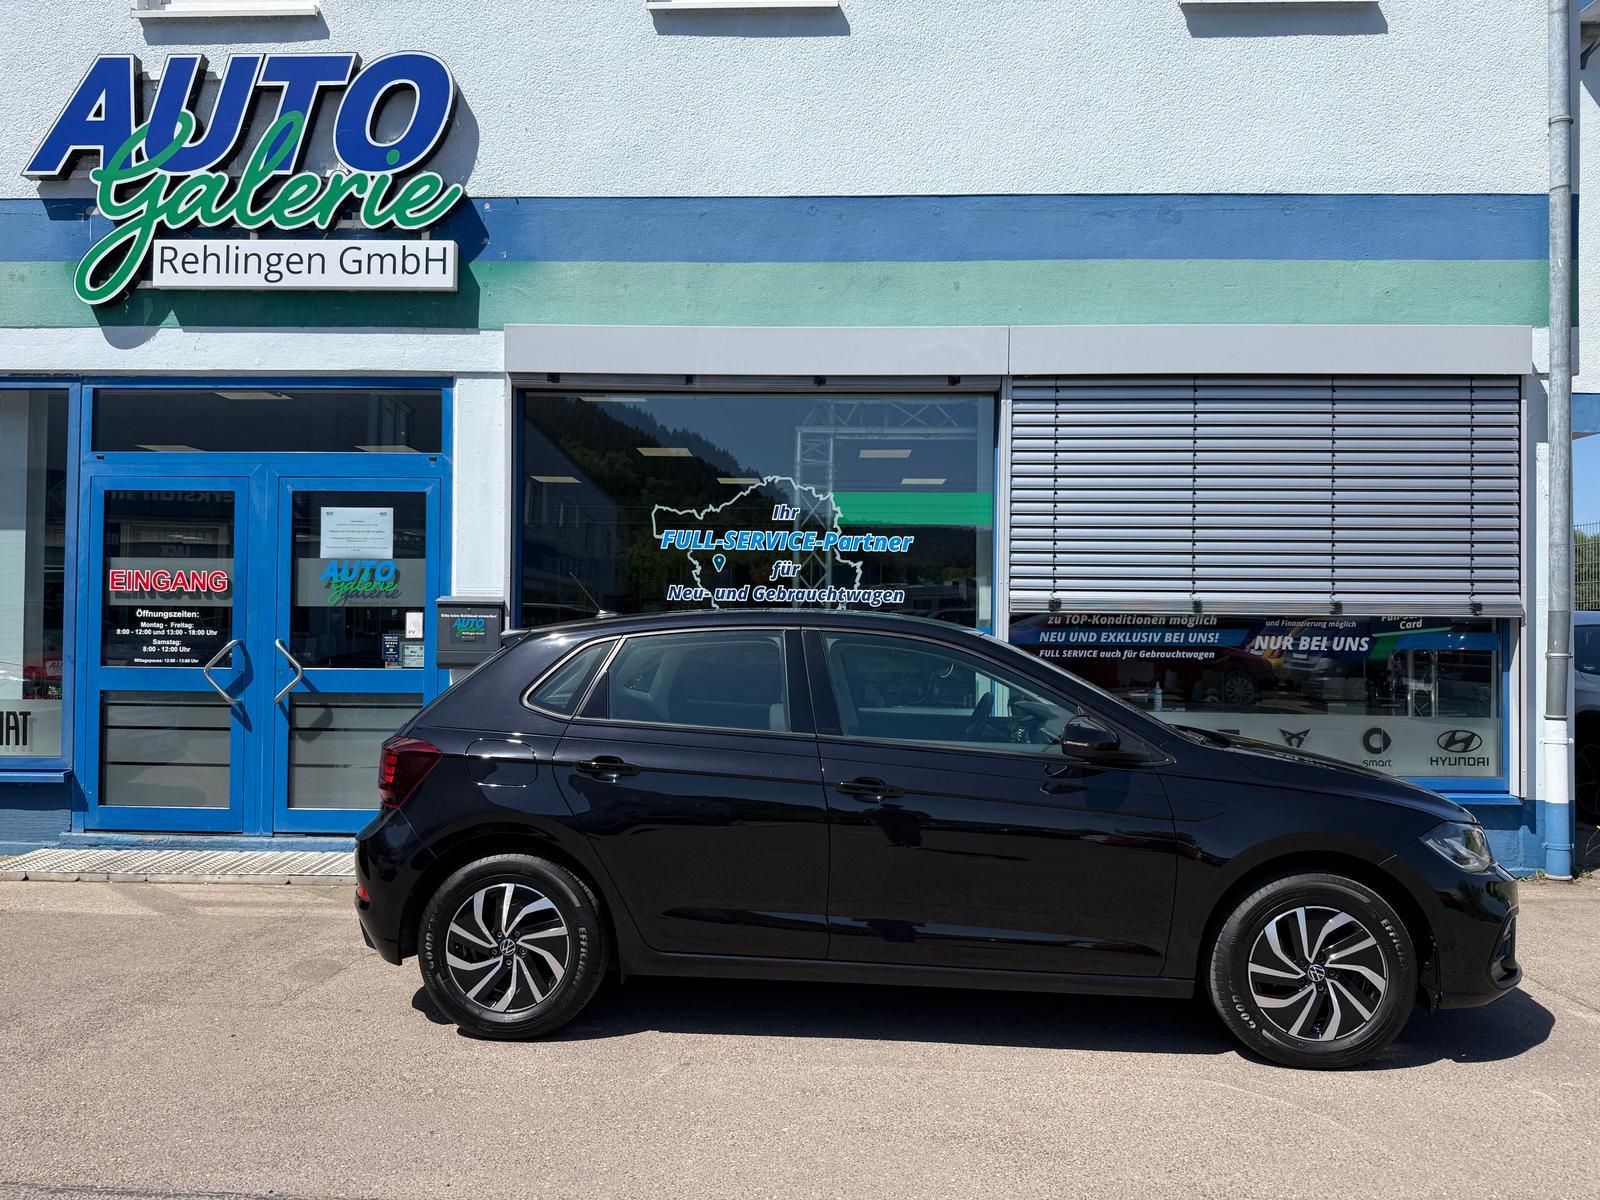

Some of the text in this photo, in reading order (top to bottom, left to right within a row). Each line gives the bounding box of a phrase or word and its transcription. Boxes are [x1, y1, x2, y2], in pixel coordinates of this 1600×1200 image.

[21, 50, 455, 176] AUTO
[73, 110, 464, 305] Galerie
[159, 245, 447, 281] Rehlingen GmbH
[771, 503, 800, 520] Ihr
[660, 529, 914, 552] FULL-SERVICE-Partner
[319, 560, 396, 581] AUTO
[770, 560, 801, 581] für
[109, 570, 228, 592] EINGANG
[667, 584, 905, 606] Neu- und Gebrauchtwagen
[136, 608, 199, 619] Öffnungszeiten:
[1048, 614, 1218, 628] zu TOP-Konditionen möglich
[1265, 619, 1357, 629] und Finanzierung möglich
[1400, 619, 1423, 630] Card
[152, 638, 181, 646] Samstag:
[1039, 632, 1219, 643] NEU UND EXKLUSIV BEI UNS!
[1254, 635, 1370, 652] NUR BEI UNS
[1039, 650, 1215, 660] FULL SERVICE auch für Gebrauchtwagen
[0, 711, 31, 746] IAT
[1362, 759, 1393, 767] smart
[1430, 756, 1489, 766] HYUNDAI
